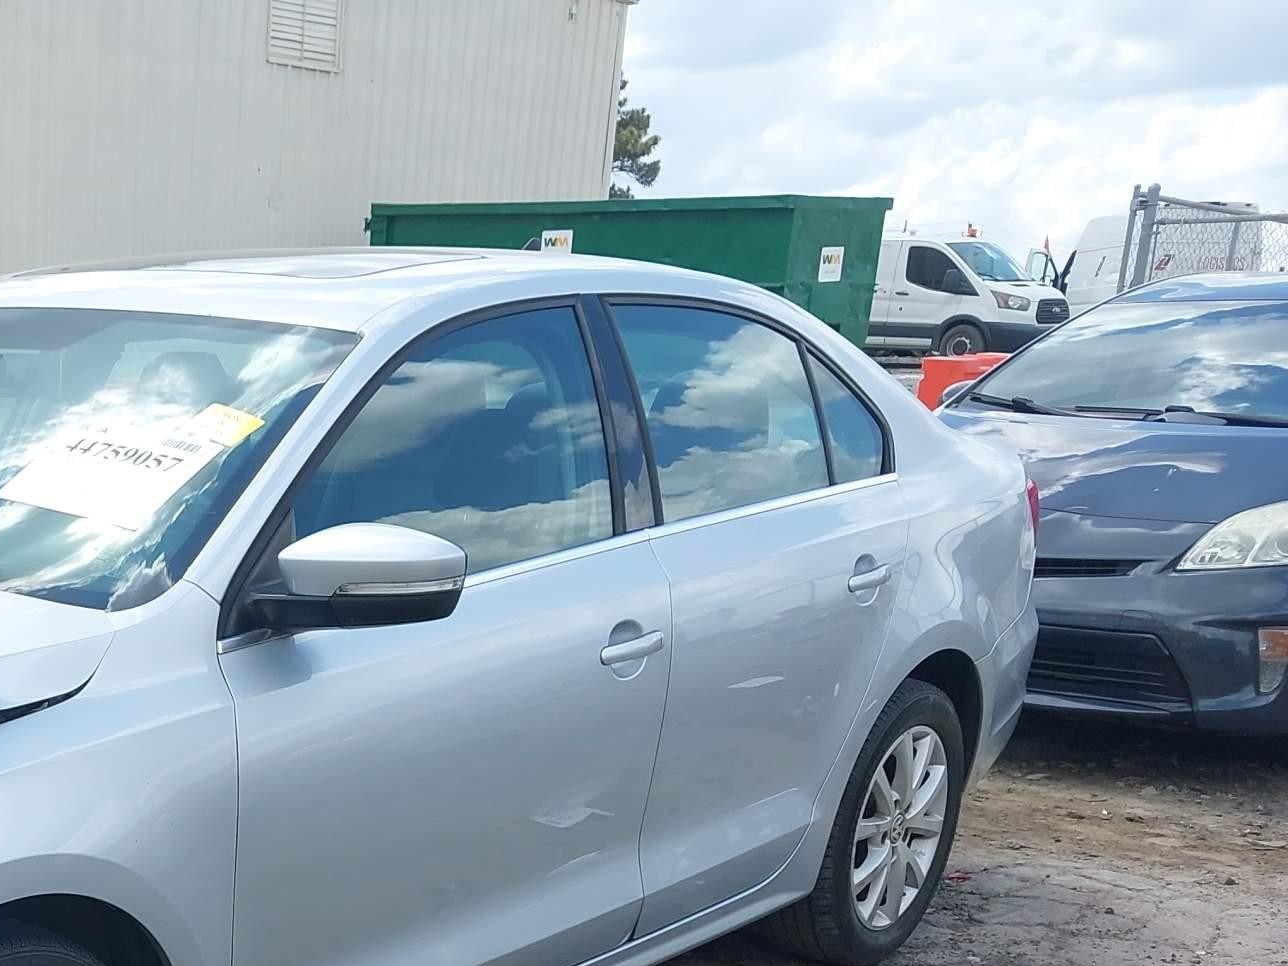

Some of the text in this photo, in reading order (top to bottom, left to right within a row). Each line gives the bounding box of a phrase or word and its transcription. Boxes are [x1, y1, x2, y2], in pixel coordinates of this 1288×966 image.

[544, 237, 569, 248] WM
[822, 254, 841, 265] WM
[1196, 256, 1249, 271] LOGISCS
[66, 438, 184, 472] 44759057
